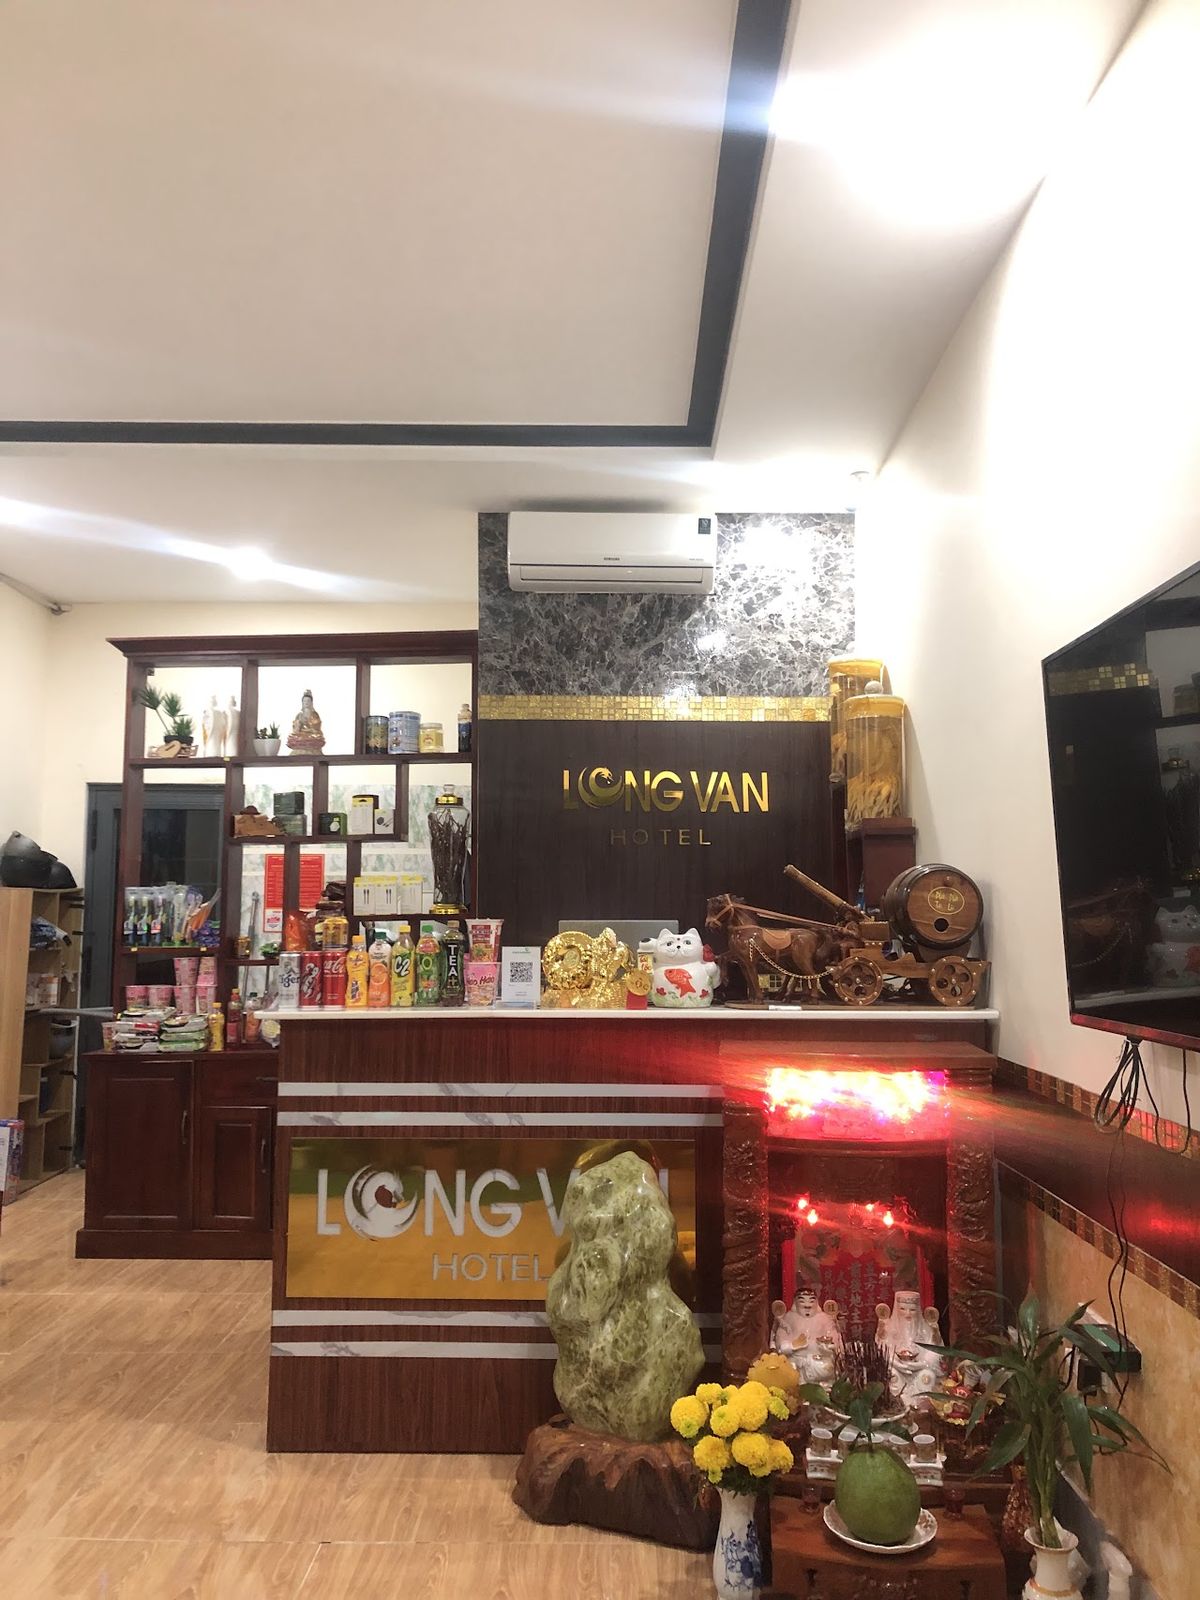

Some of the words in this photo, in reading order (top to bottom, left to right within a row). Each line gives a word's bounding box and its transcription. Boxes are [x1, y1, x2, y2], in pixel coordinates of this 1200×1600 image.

[563, 767, 684, 812] LONG
[690, 771, 769, 813] VAN
[610, 829, 711, 846] HOTEL
[394, 956, 411, 977] C2
[279, 973, 301, 988] iger
[317, 1164, 523, 1240] LONG
[432, 1253, 554, 1282] HOTEL
